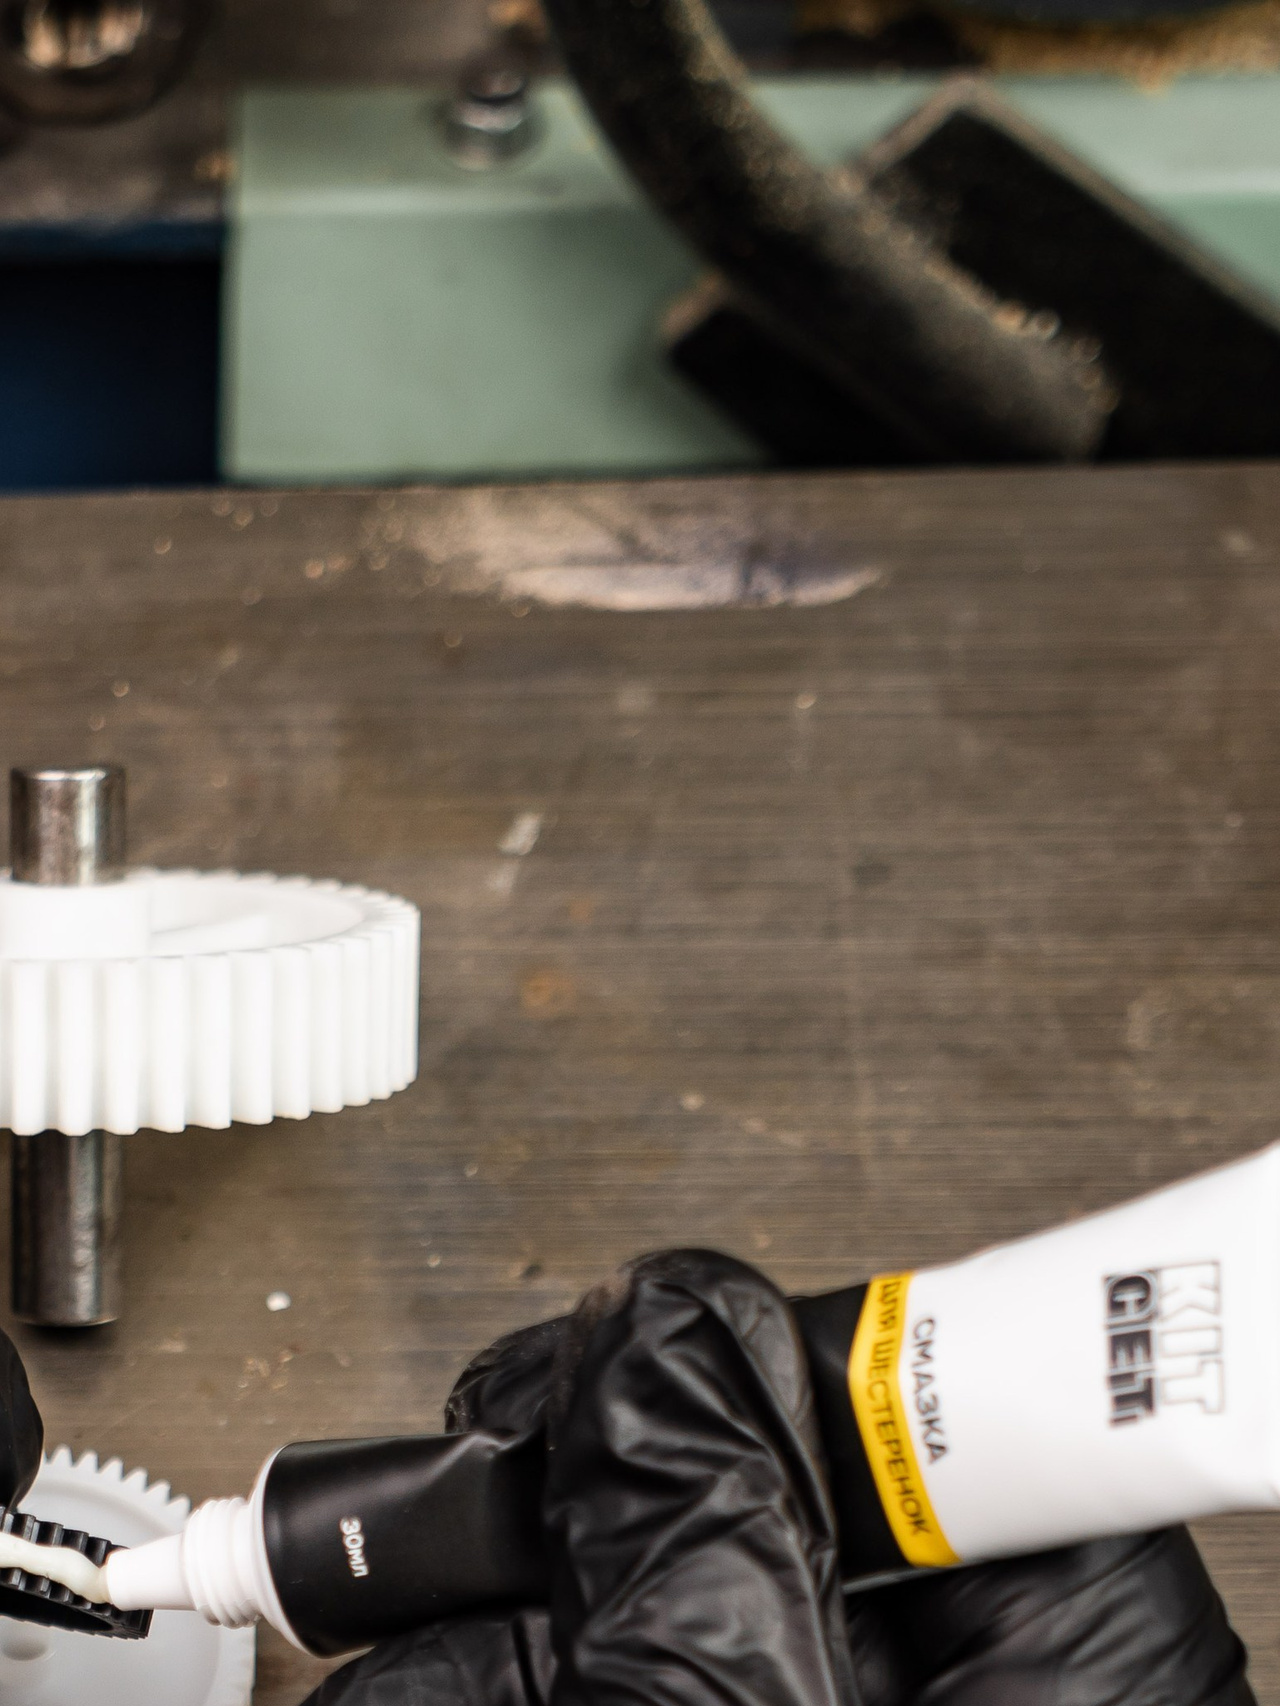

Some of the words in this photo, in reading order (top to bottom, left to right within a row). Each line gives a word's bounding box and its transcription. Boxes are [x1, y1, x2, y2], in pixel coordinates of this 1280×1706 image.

[879, 1281, 903, 1332] ДЛЯ
[1159, 1261, 1225, 1413] KIT
[868, 1339, 930, 1535] ШЕСТЕРЕНОК
[912, 1318, 949, 1462] СМАЗКА
